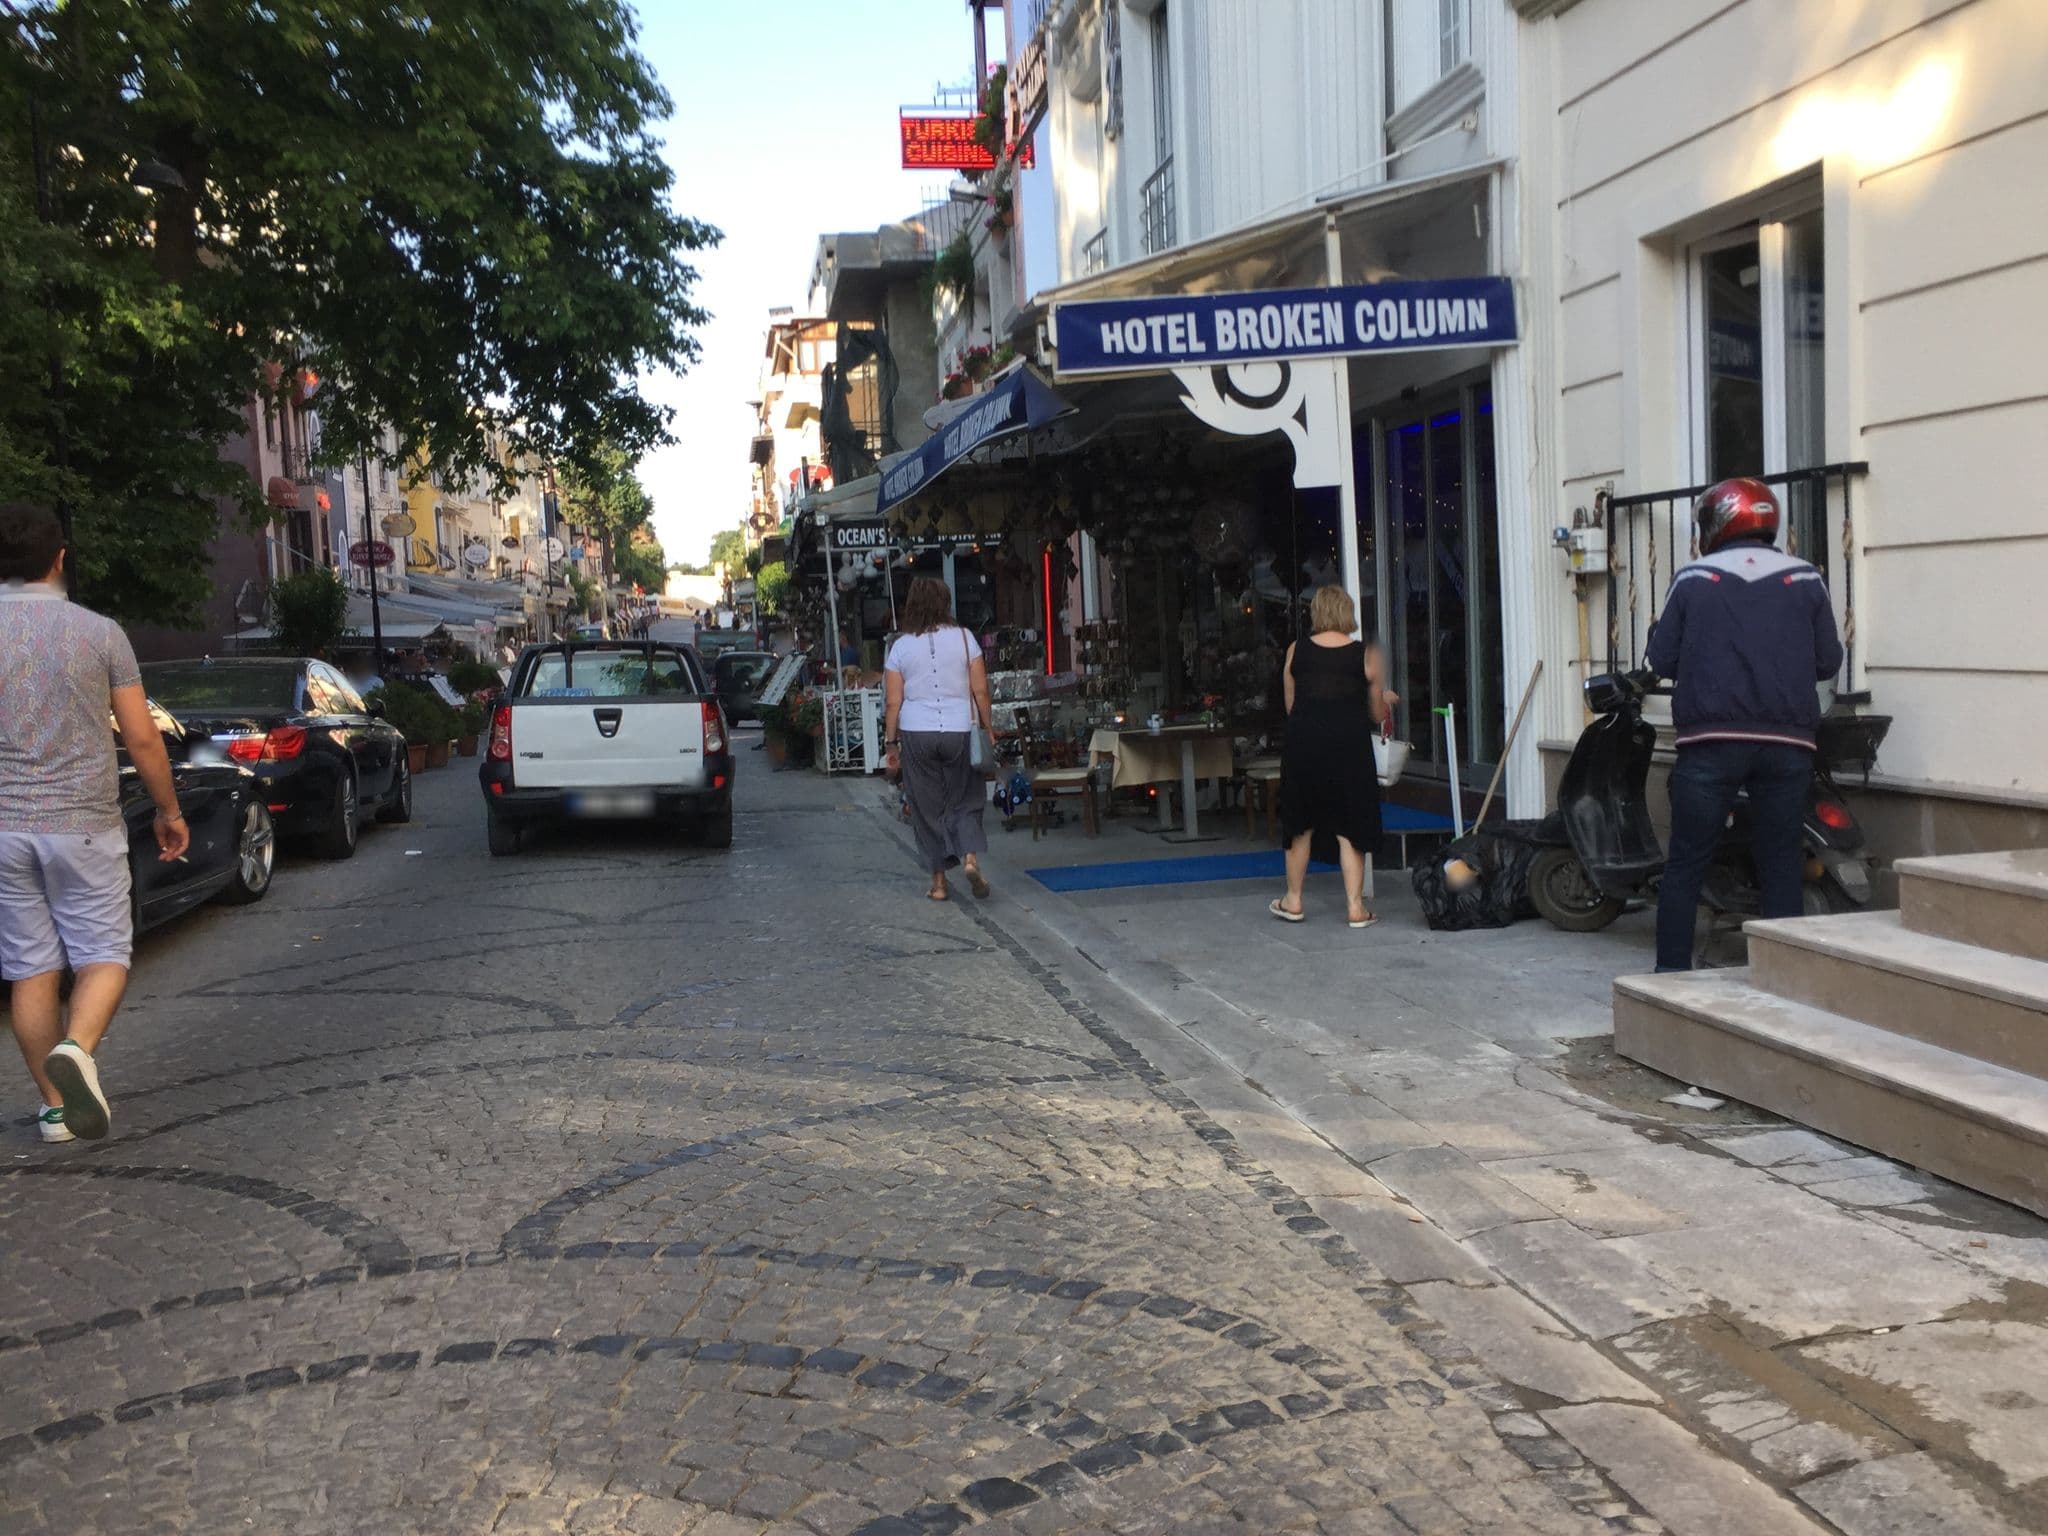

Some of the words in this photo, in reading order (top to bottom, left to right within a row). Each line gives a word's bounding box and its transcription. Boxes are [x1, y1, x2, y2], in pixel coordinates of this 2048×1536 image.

[1100, 314, 1206, 354] HOTEL
[1214, 302, 1345, 352] BROKEN
[1354, 299, 1489, 343] COLUMN
[837, 527, 886, 546] OCEAN'S
